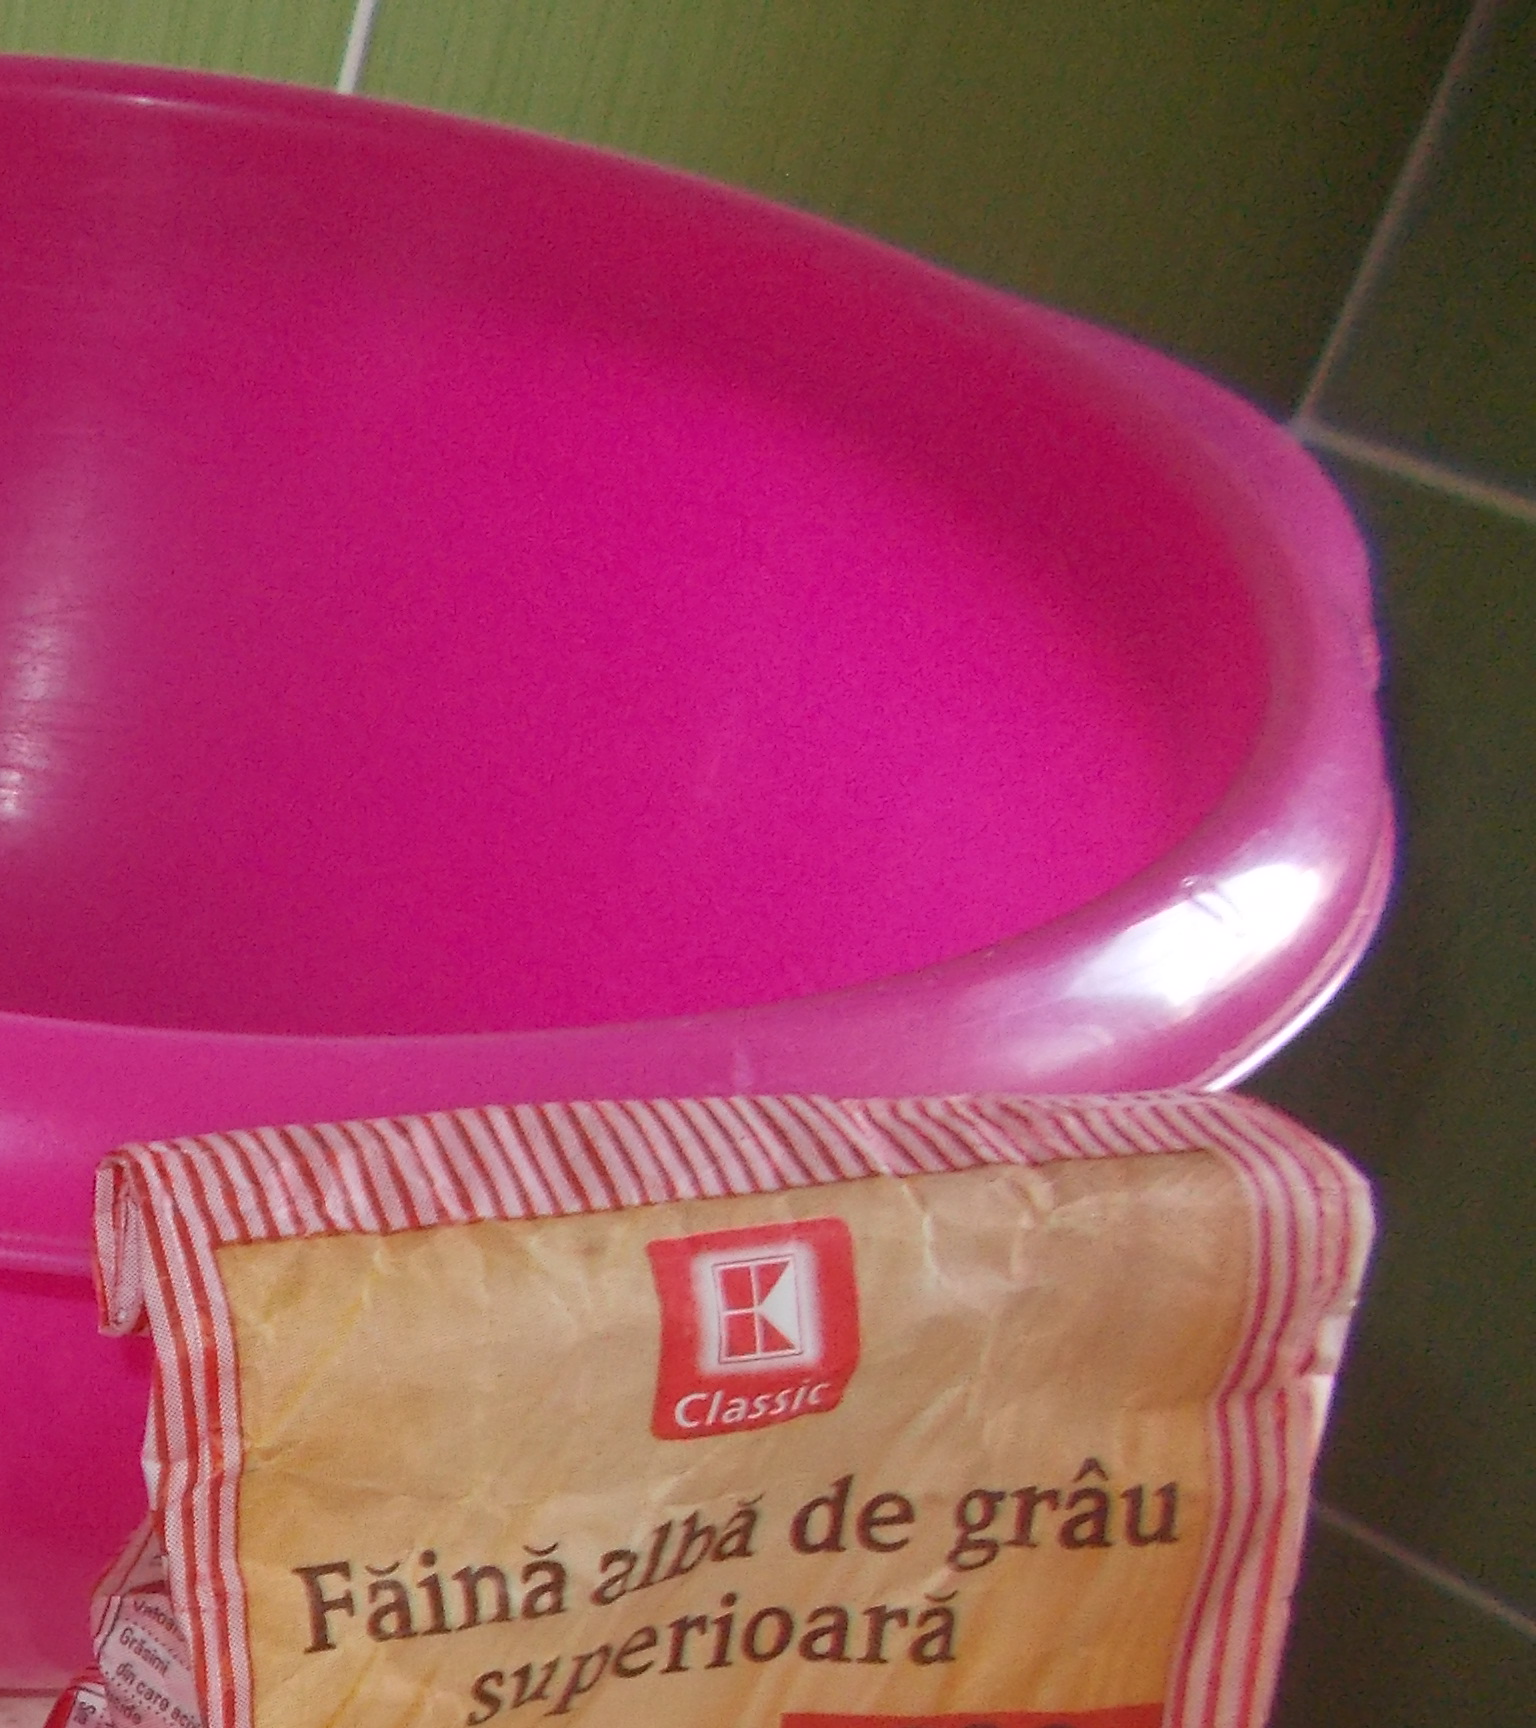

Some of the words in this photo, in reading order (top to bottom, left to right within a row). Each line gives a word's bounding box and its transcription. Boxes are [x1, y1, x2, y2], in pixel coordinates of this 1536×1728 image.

[672, 1378, 830, 1432] Classic
[292, 1543, 569, 1656] Făină
[588, 1490, 764, 1608] albă
[788, 1474, 915, 1556] de
[945, 1456, 1182, 1574] grâu
[465, 1590, 958, 1728] superioară
